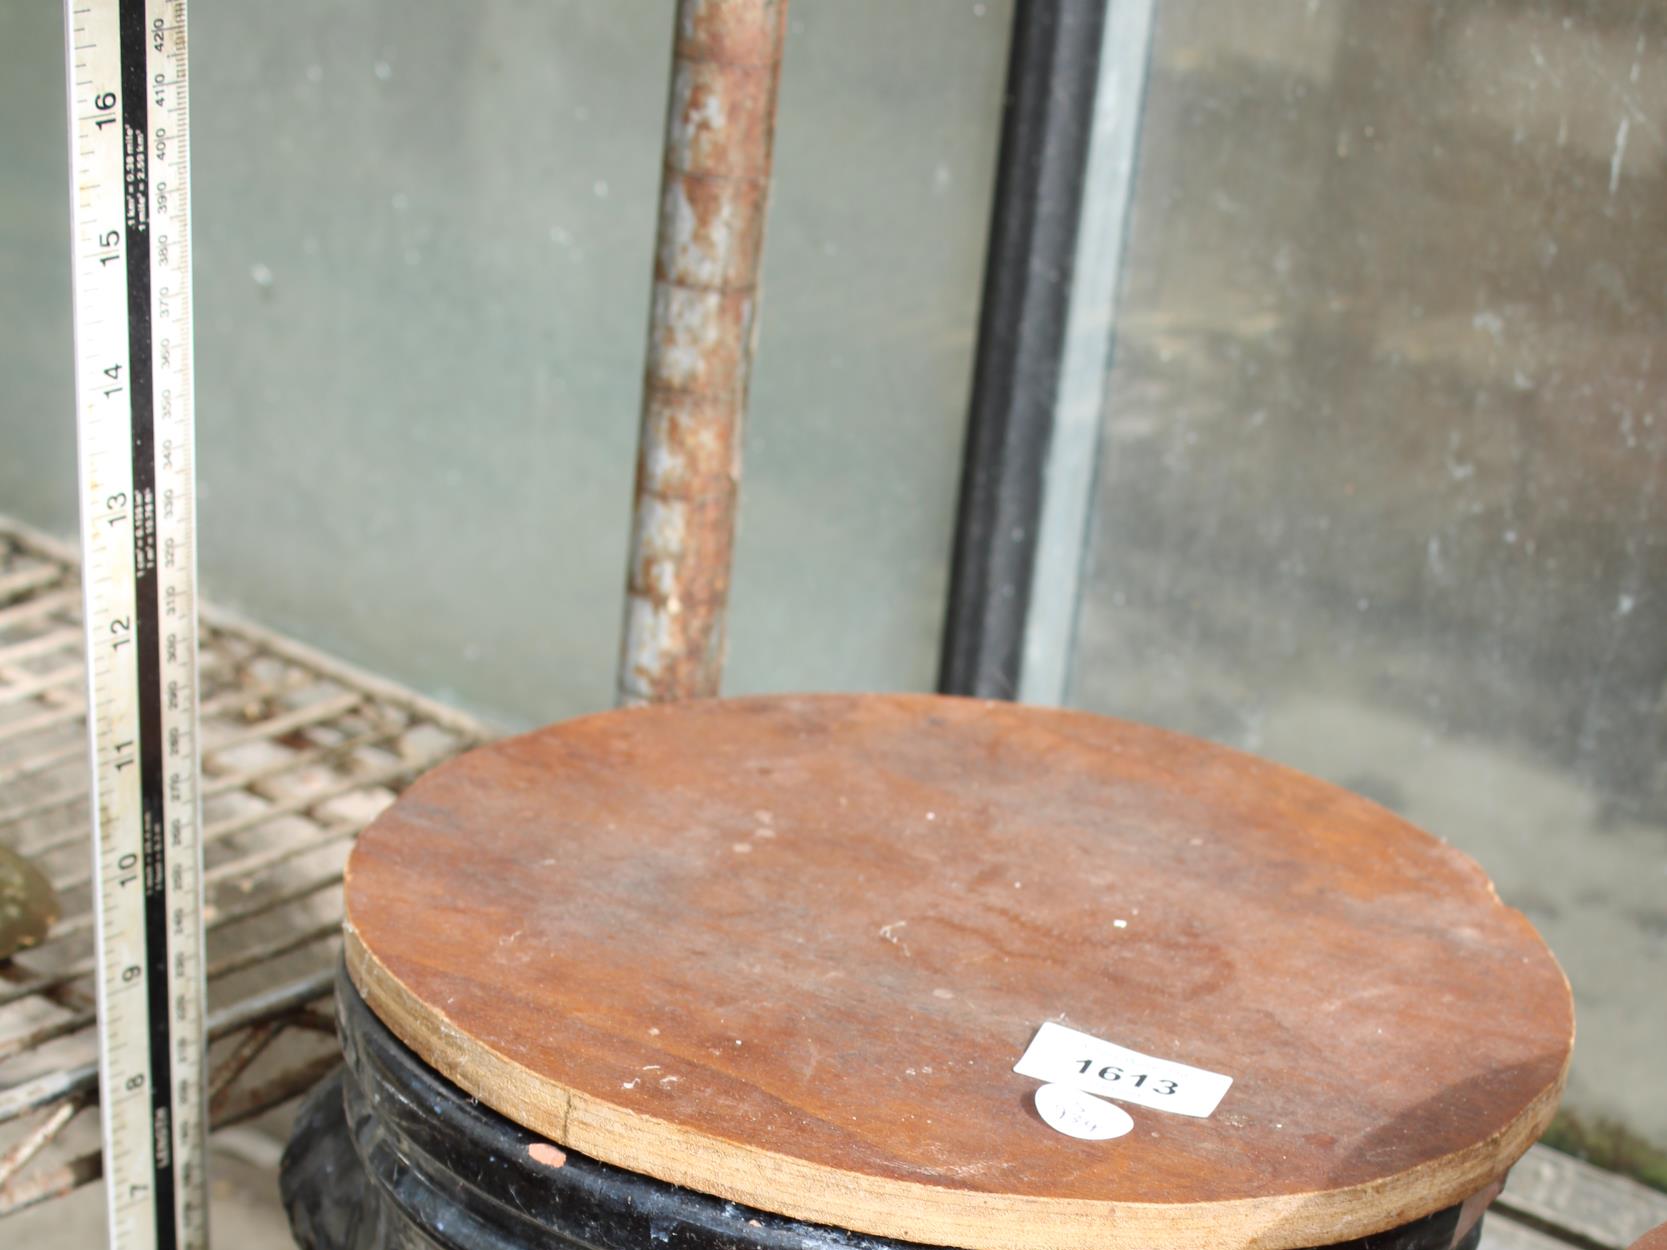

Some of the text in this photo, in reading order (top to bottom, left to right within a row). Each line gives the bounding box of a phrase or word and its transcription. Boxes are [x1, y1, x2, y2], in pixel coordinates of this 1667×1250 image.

[153, 18, 165, 52] 420
[154, 73, 165, 107] 410
[95, 92, 117, 131] 16
[155, 128, 166, 161] 400
[156, 181, 168, 214] 390
[137, 224, 146, 232] 1
[99, 230, 120, 267] 15
[157, 234, 169, 267] 380
[159, 286, 169, 318] 370
[104, 363, 123, 399] 14
[162, 439, 173, 470] 340
[106, 492, 127, 527] 13
[164, 538, 174, 568] 320
[166, 586, 176, 616] 310
[110, 616, 130, 652] 12
[114, 740, 134, 772] 11
[118, 853, 138, 888] 10
[122, 965, 142, 982] 9
[126, 1073, 144, 1091] 8
[1075, 1059, 1179, 1095] 1613
[129, 1184, 149, 1199] 7
